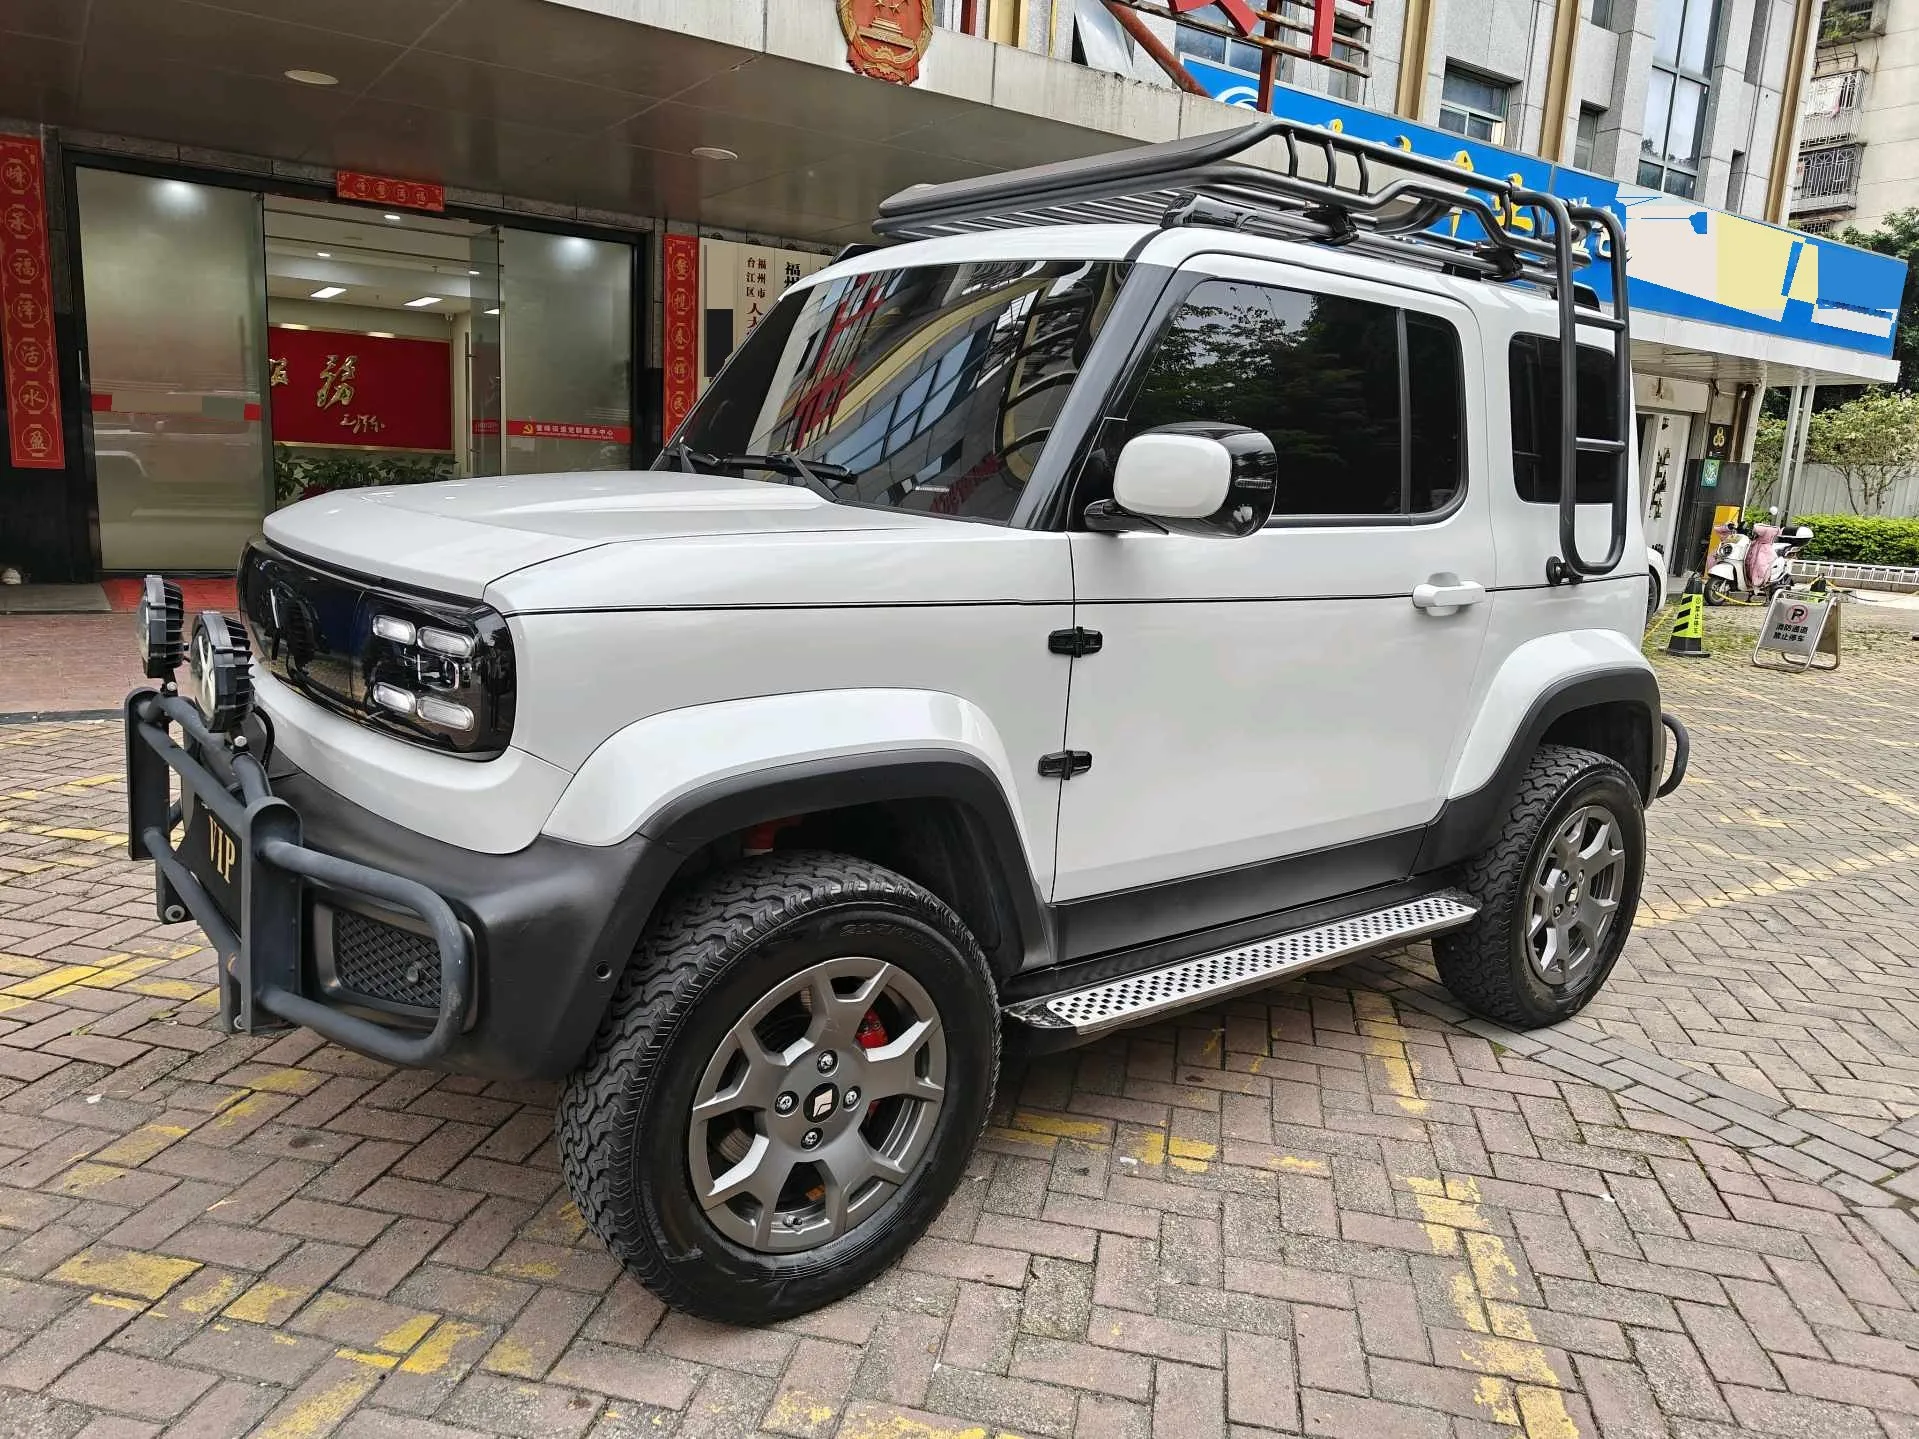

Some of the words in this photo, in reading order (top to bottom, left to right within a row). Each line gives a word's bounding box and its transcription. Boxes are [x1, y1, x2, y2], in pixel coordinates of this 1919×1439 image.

[746, 257, 756, 298] 台江区
[757, 258, 767, 299] 福州市
[746, 302, 763, 336] 人大
[1773, 631, 1806, 642] 禁止停车
[1775, 623, 1809, 634] 消防通道
[208, 815, 236, 884] VIP
